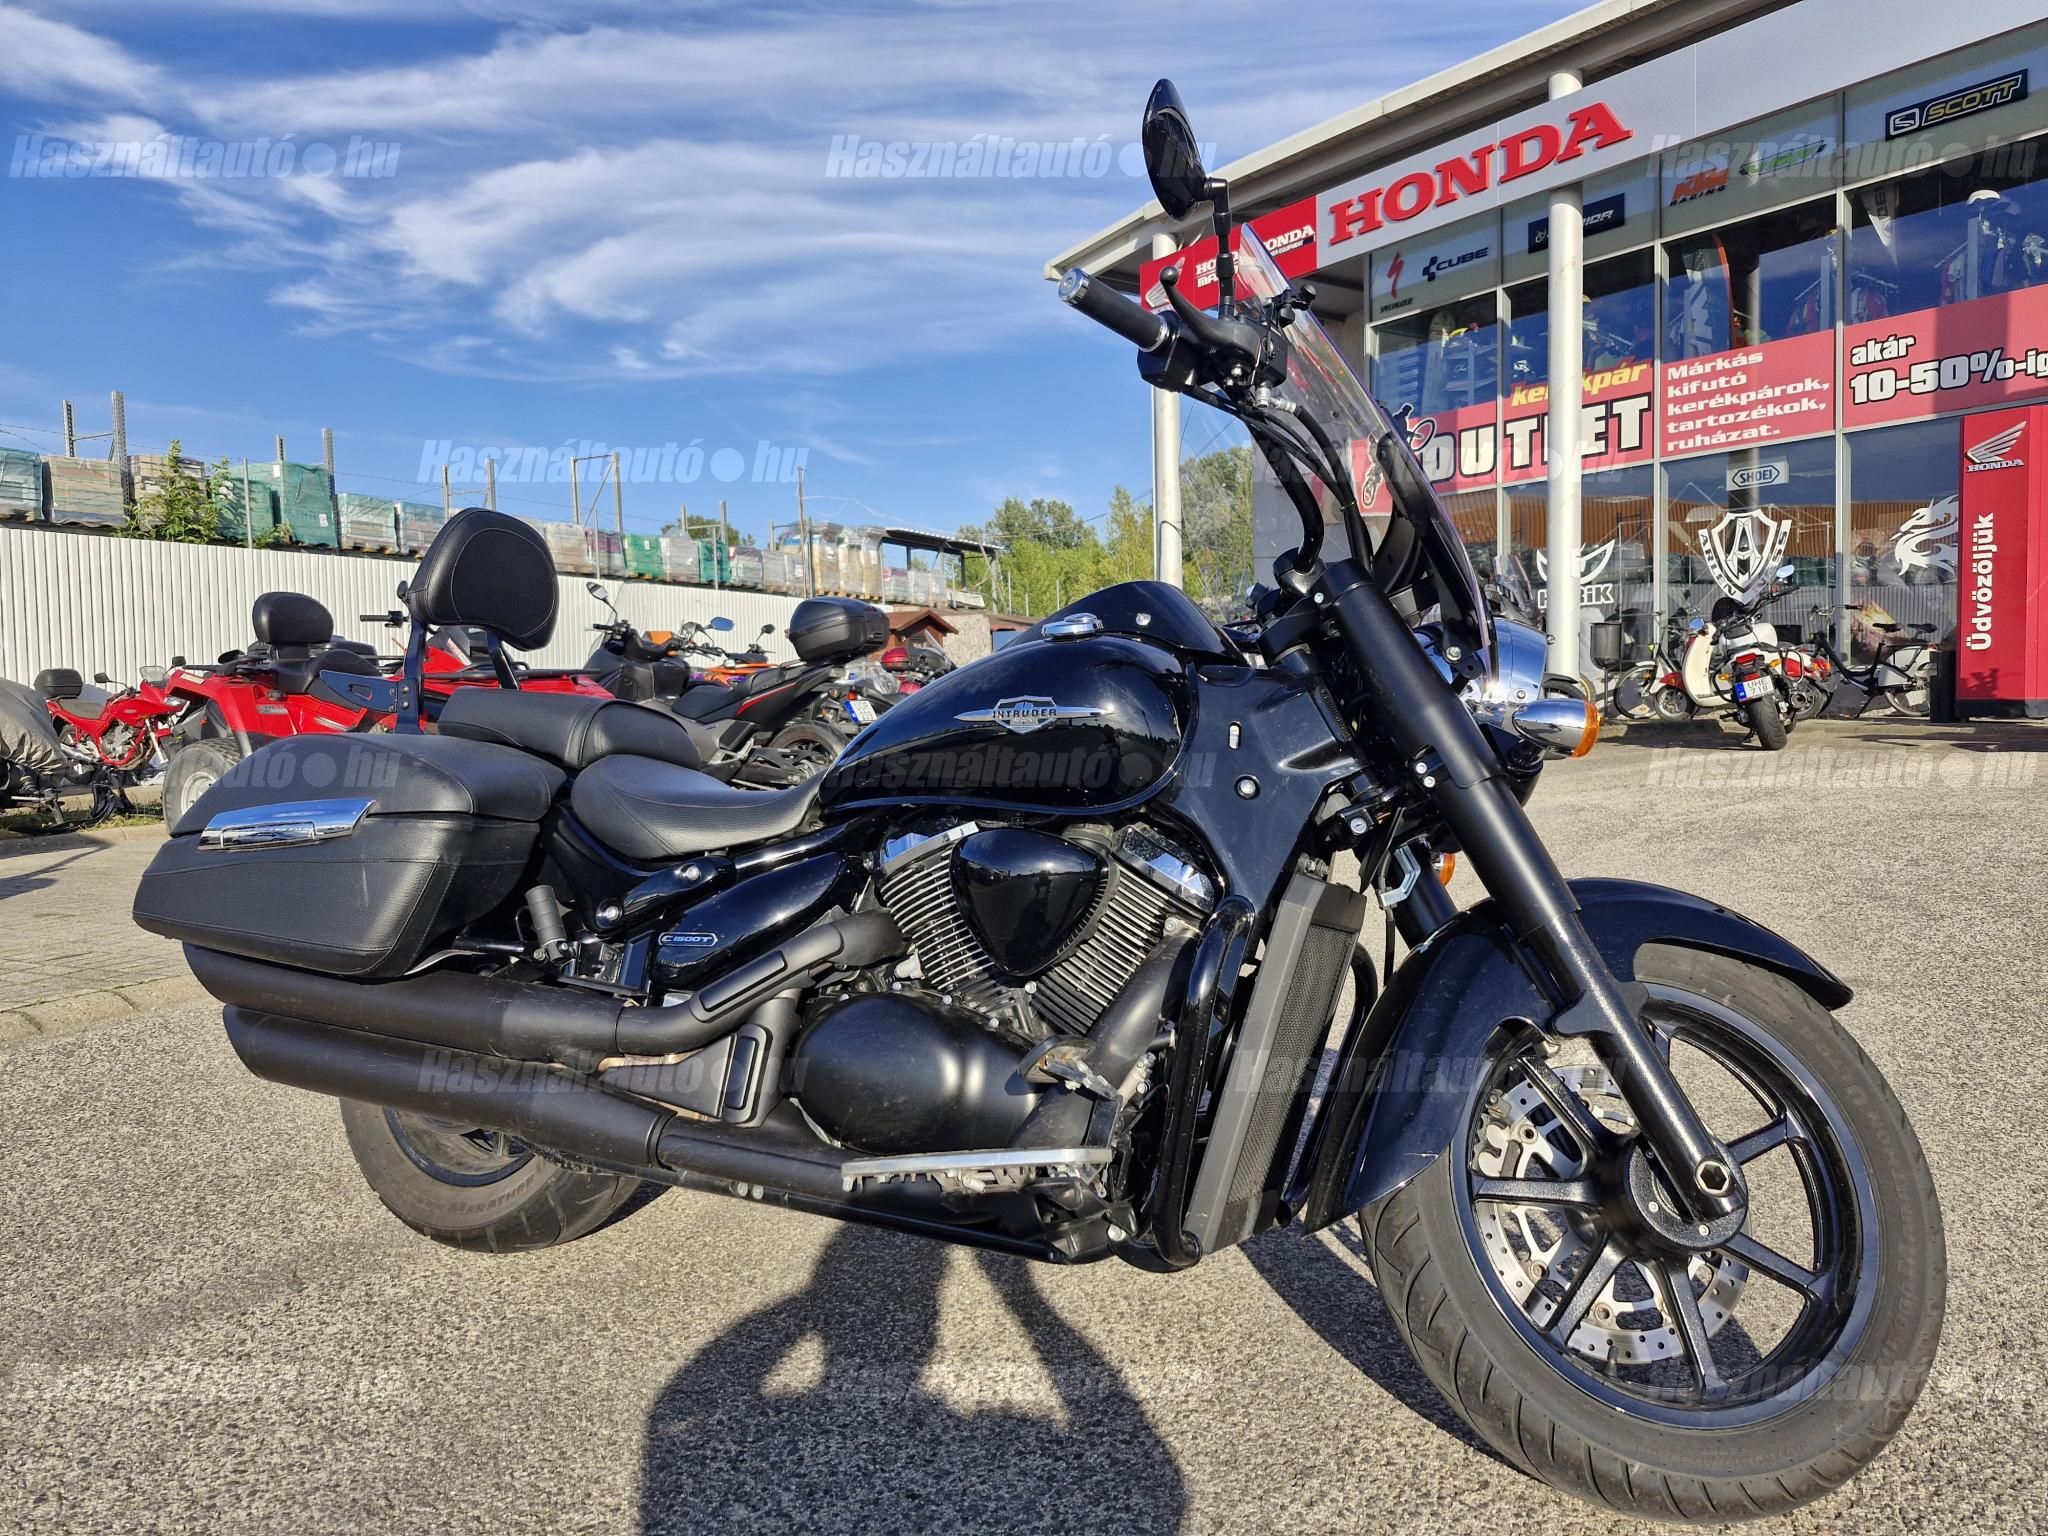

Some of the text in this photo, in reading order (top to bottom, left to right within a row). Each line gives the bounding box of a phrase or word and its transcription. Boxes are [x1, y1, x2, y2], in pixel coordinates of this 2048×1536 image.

[1927, 80, 2018, 121] SCOTT
[1330, 101, 1634, 247] HONDA
[1671, 167, 1729, 201] KTM
[1669, 185, 1727, 207] RACING
[1263, 225, 1316, 252] ONDA
[1435, 247, 1489, 272] CUBE
[1850, 334, 1916, 366] akár
[1667, 352, 1764, 381] Márkás
[1667, 371, 1748, 399] kifutó
[1667, 377, 1830, 417] kerékpárok,
[1666, 397, 1828, 434] tartozékok,
[1420, 391, 1652, 484] OUTET
[1667, 424, 1781, 452] ruházat.
[1739, 469, 1774, 485] SHOEI
[1967, 459, 2025, 473] HONDA
[1700, 533, 1737, 597] ARLEN
[1966, 512, 1998, 651] Üdvözöljük
[992, 708, 1057, 719] INTRUDER
